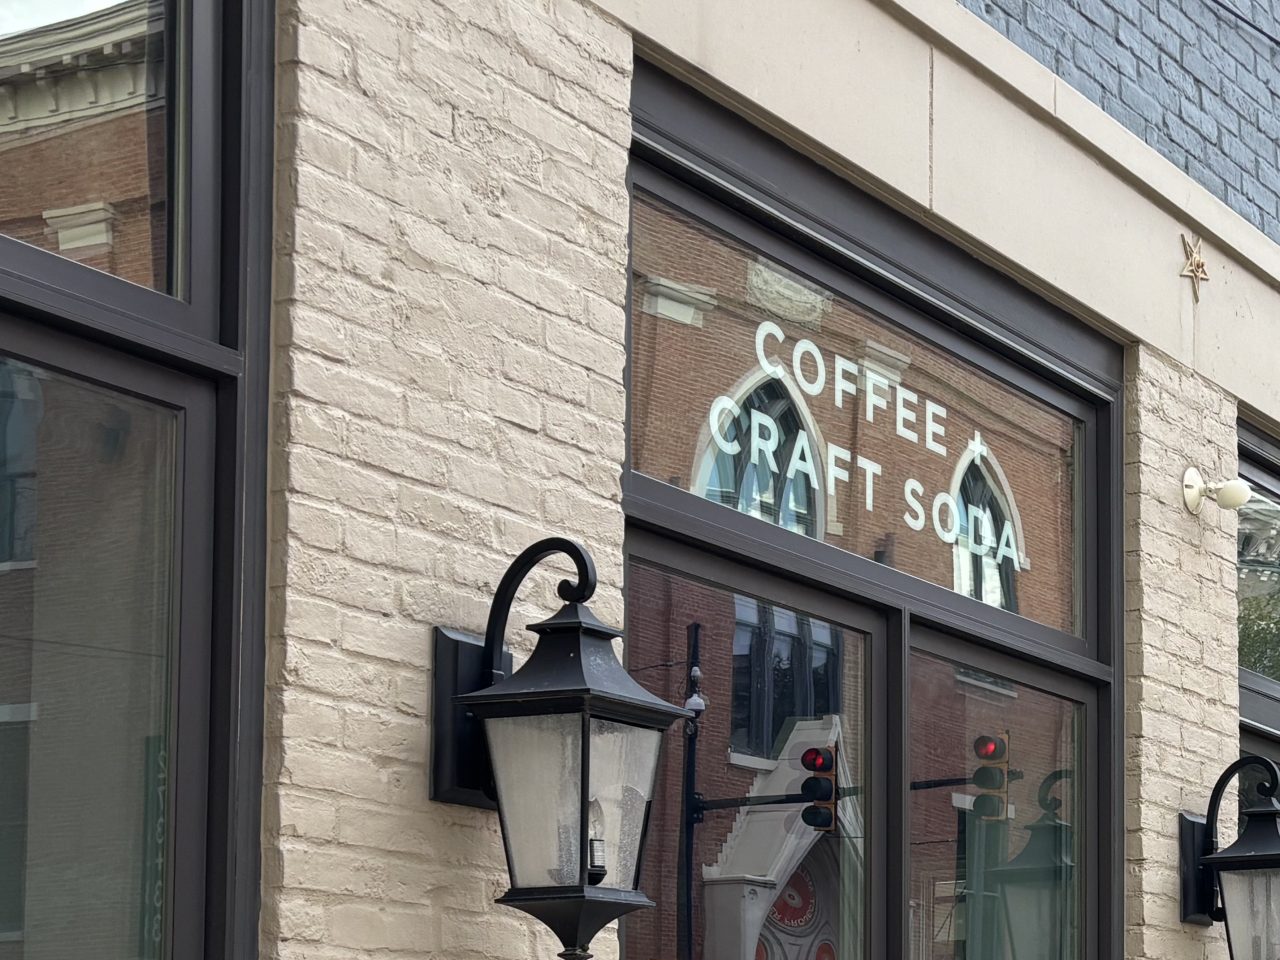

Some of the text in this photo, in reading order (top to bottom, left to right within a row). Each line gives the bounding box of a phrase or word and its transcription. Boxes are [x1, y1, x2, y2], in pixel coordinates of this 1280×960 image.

[755, 320, 947, 457] COFFEE
[708, 395, 1022, 573] CRAFT SODA
